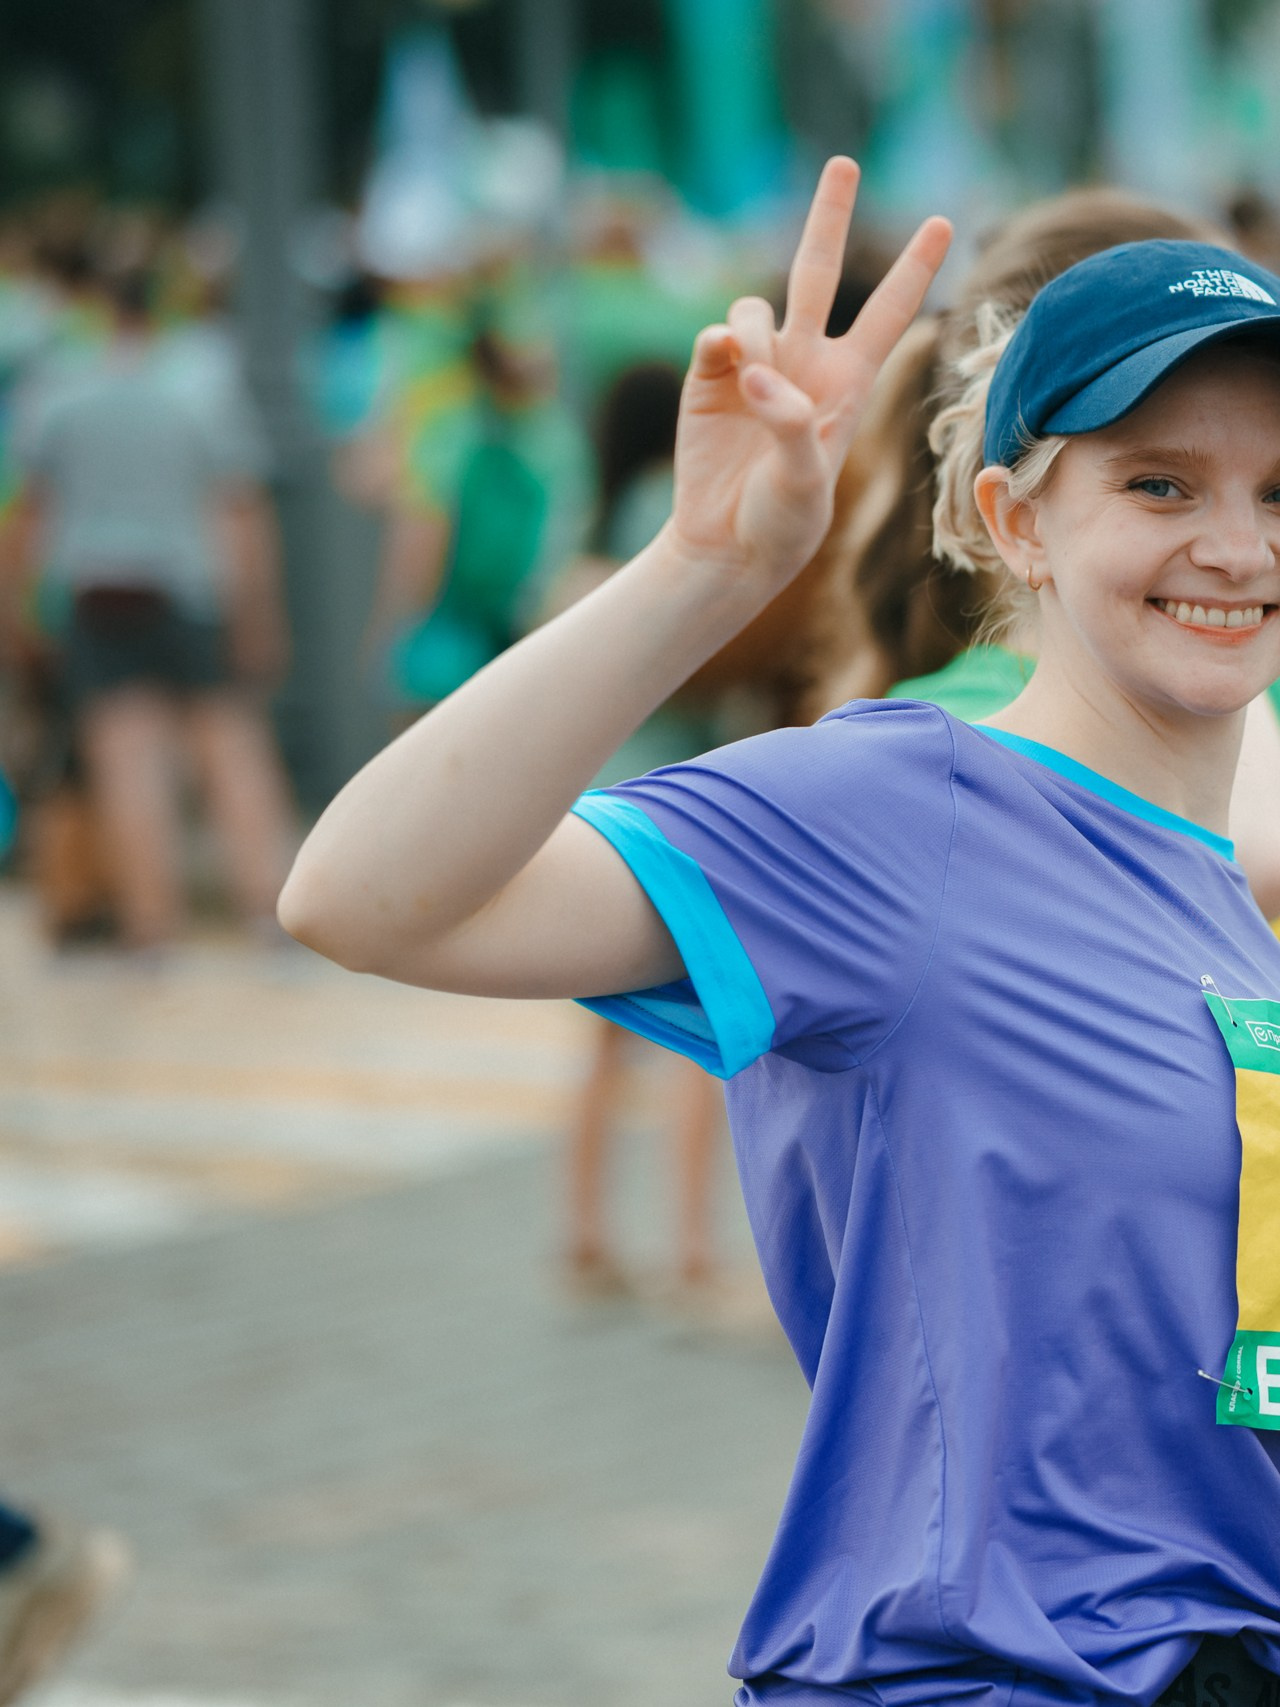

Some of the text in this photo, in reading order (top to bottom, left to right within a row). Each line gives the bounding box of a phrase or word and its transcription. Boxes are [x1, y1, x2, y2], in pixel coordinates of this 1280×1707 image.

[1192, 269, 1232, 281] THE
[1168, 276, 1240, 294] NORTH
[1192, 287, 1243, 297] FACE
